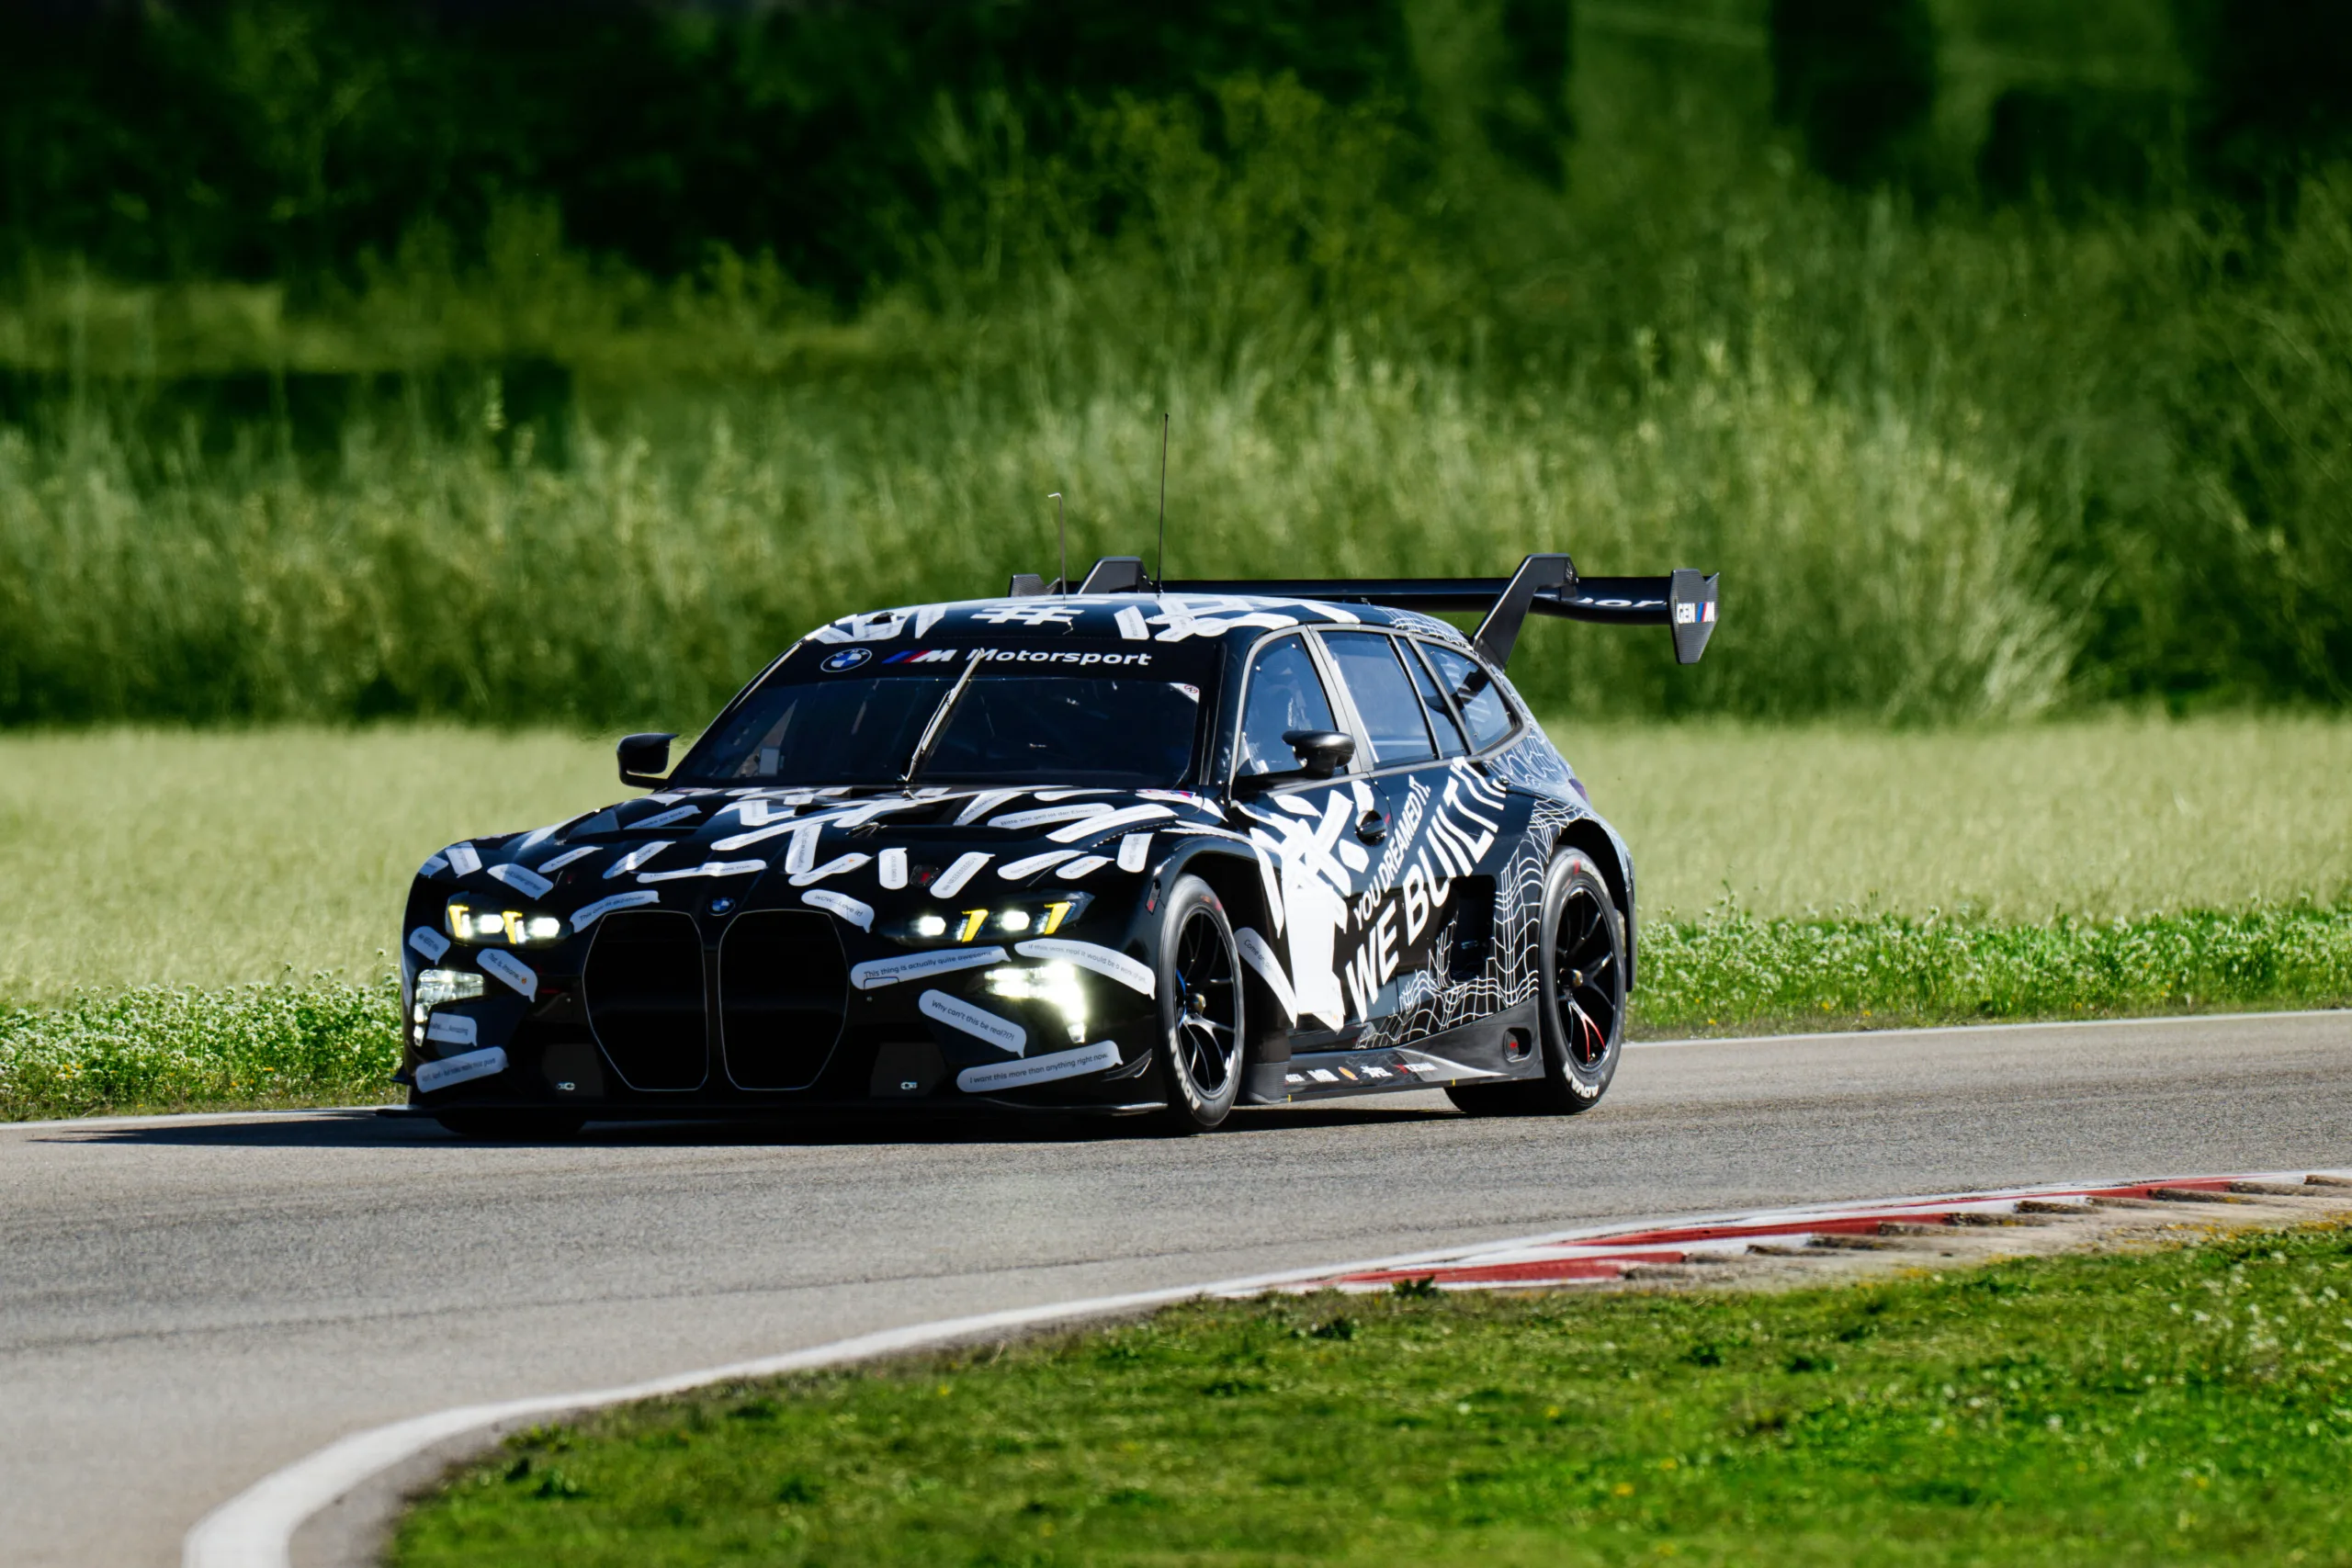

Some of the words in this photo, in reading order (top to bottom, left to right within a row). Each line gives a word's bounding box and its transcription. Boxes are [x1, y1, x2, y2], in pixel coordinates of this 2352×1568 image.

[966, 648, 1153, 666] Motorsport
[1353, 875, 1382, 931] YOU
[1377, 791, 1423, 894] DREAMED
[1345, 899, 1400, 1023] WE
[1402, 775, 1499, 947] BUILT
[1066, 947, 1080, 956] real
[1087, 953, 1107, 964] would
[1107, 958, 1115, 968] be
[1243, 939, 1260, 956] Come
[864, 970, 880, 979] This
[880, 966, 899, 976] thing
[908, 959, 936, 971] actually
[937, 955, 956, 965] quite
[932, 999, 947, 1013] Why
[947, 1008, 966, 1021] can't
[966, 1014, 979, 1026] this
[979, 1021, 989, 1031] be
[973, 1075, 992, 1084] want
[993, 1071, 1008, 1081] this
[1008, 1069, 1027, 1078] more
[1027, 1066, 1045, 1076] than
[1046, 1060, 1077, 1073] anything
[1076, 1055, 1093, 1066] right
